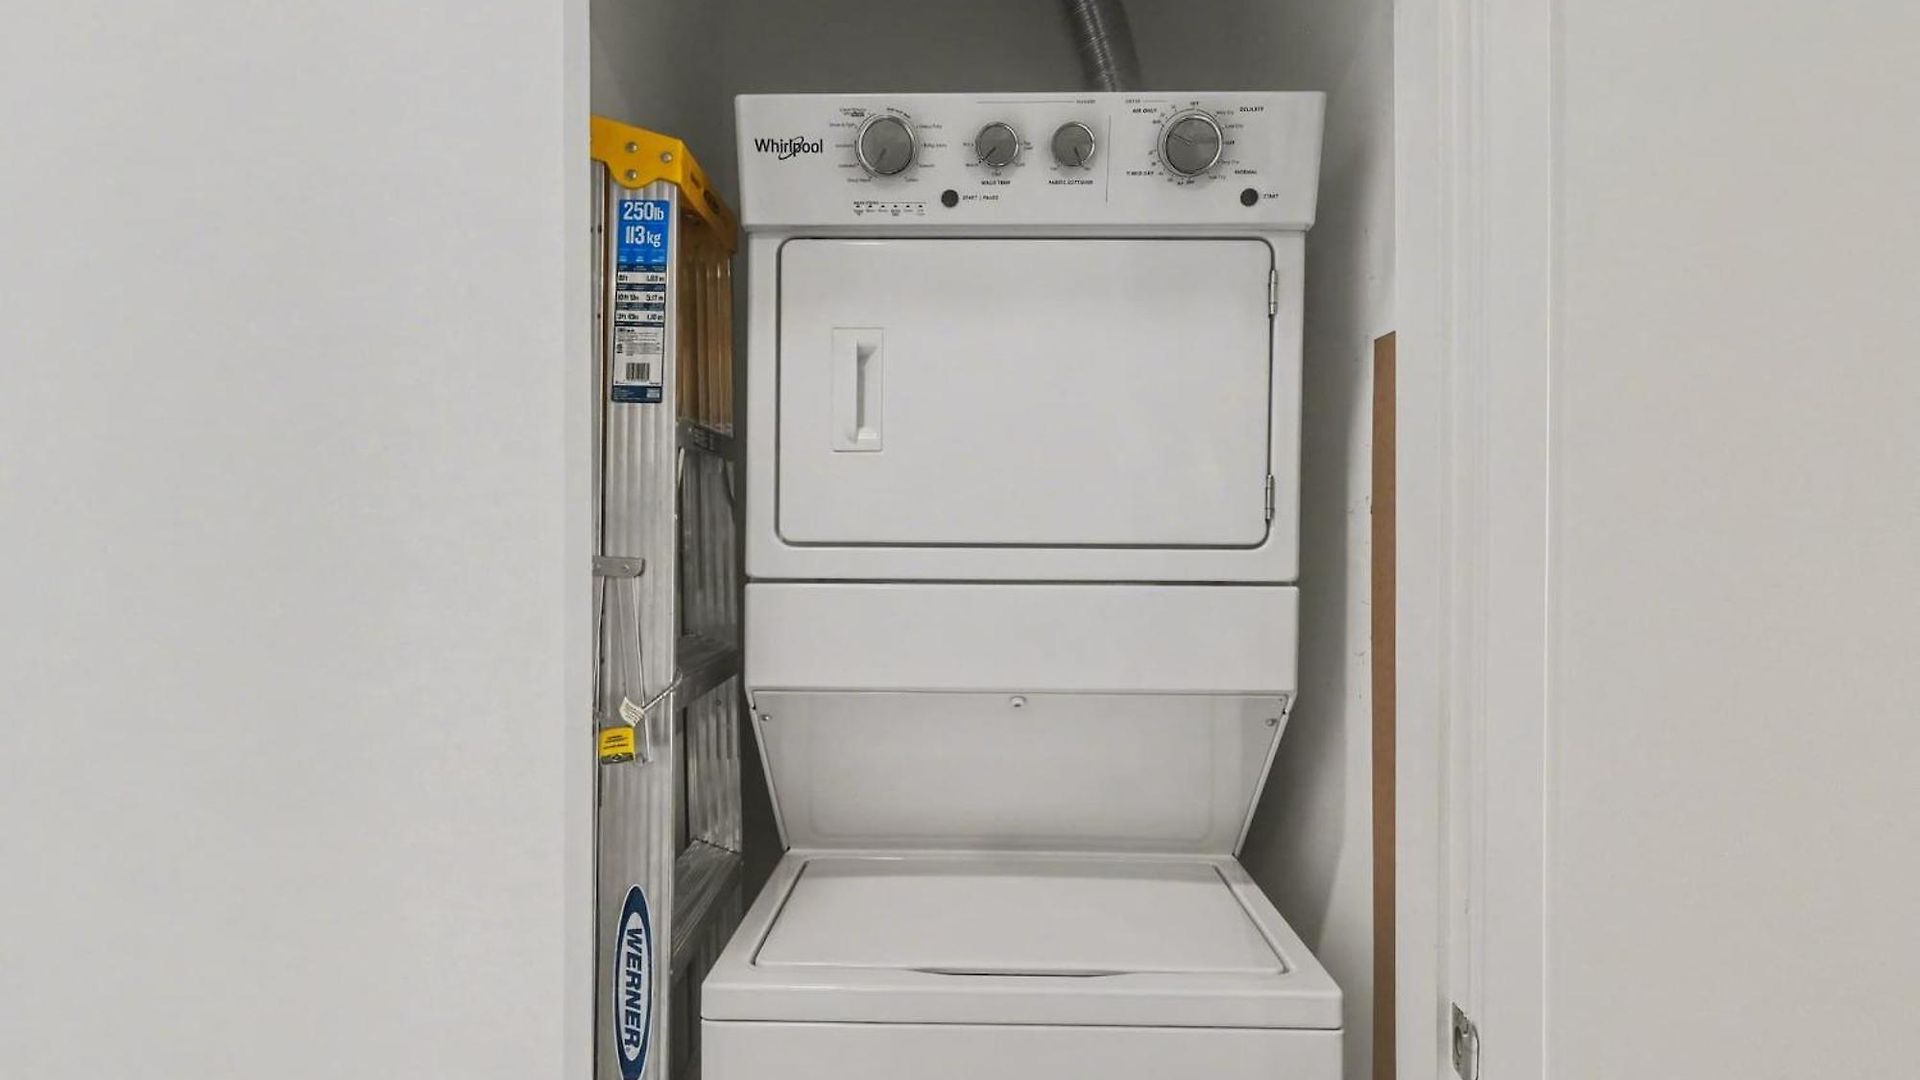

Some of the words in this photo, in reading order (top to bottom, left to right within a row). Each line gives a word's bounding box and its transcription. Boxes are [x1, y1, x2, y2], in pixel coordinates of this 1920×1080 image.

[754, 136, 824, 161] Whirlpool
[623, 201, 664, 221] 250lb
[625, 225, 646, 245] 113
[646, 231, 661, 248] kg
[615, 928, 643, 1050] WERNER
